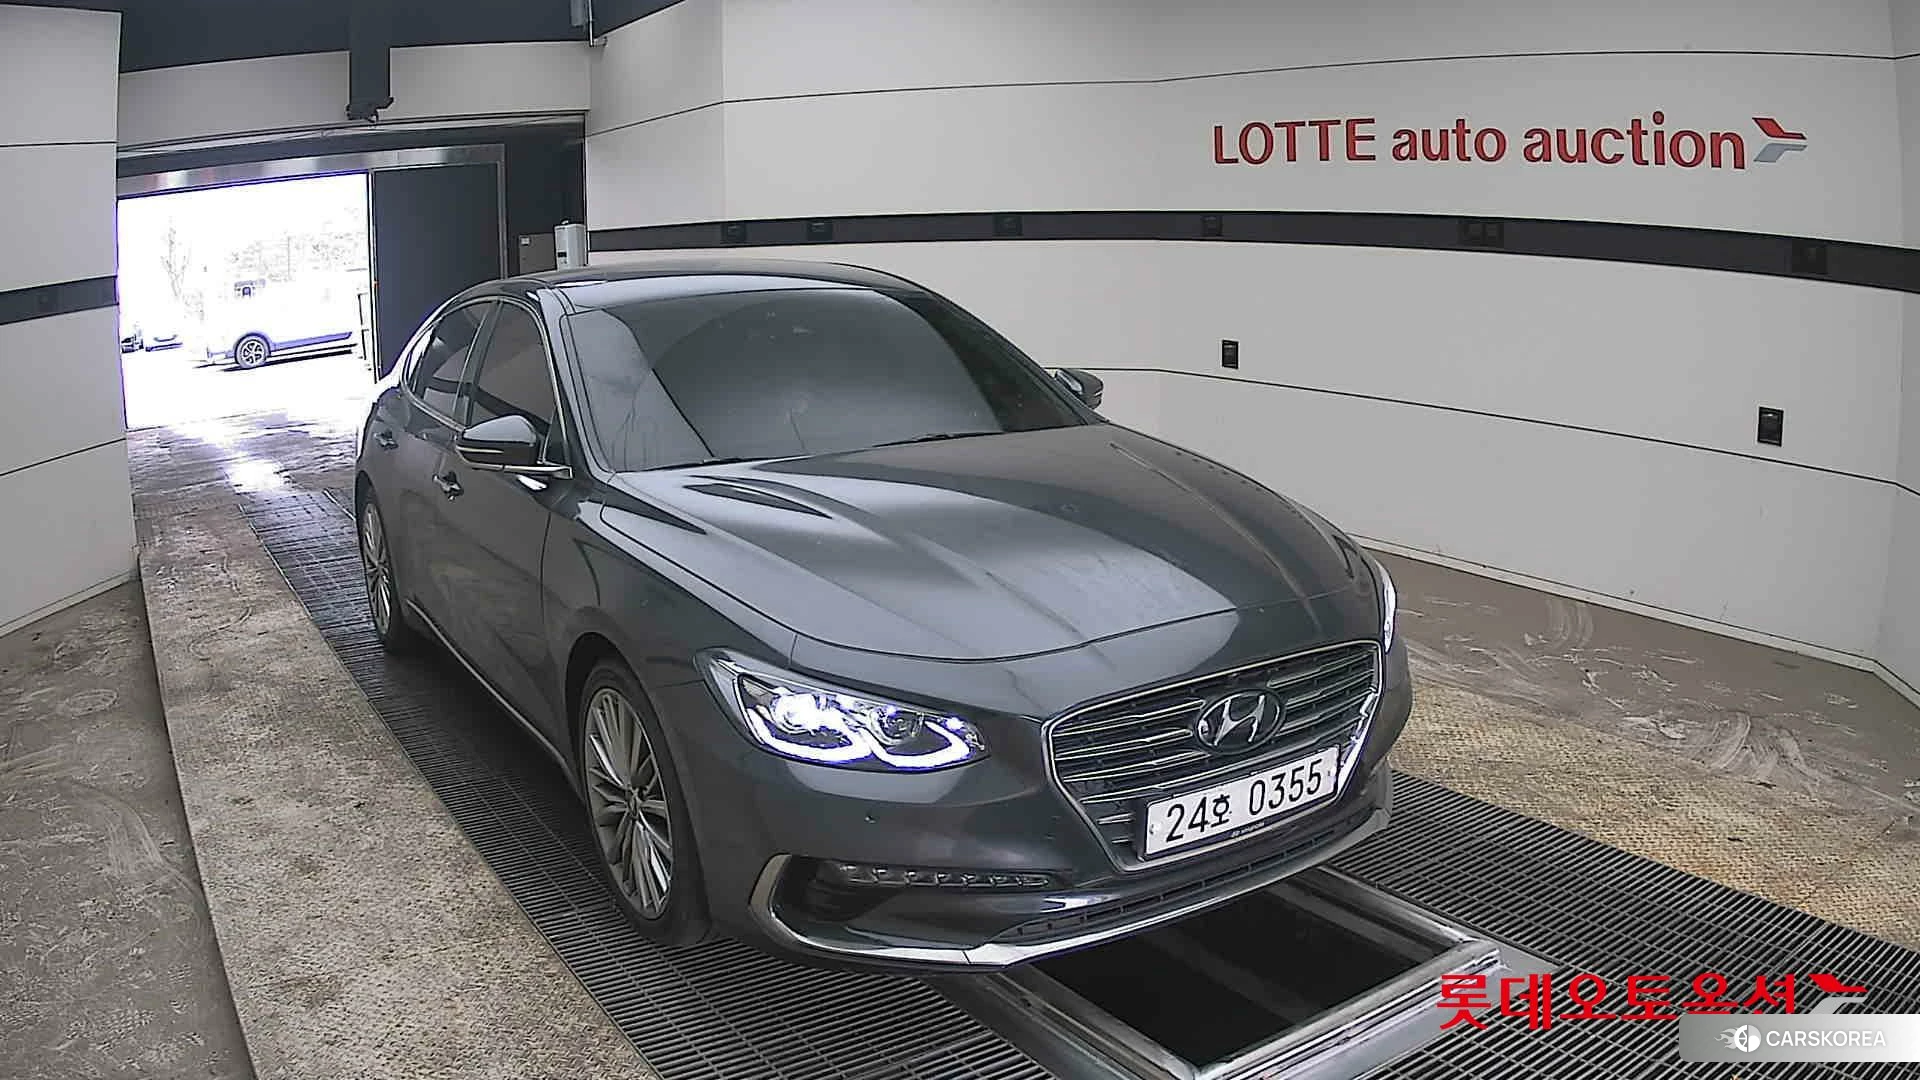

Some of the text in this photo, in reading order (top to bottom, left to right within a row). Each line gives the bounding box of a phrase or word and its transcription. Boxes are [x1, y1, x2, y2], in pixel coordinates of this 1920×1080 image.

[1213, 110, 1746, 170] LOTTE auto auction
[1165, 758, 1323, 843] 24호 0355
